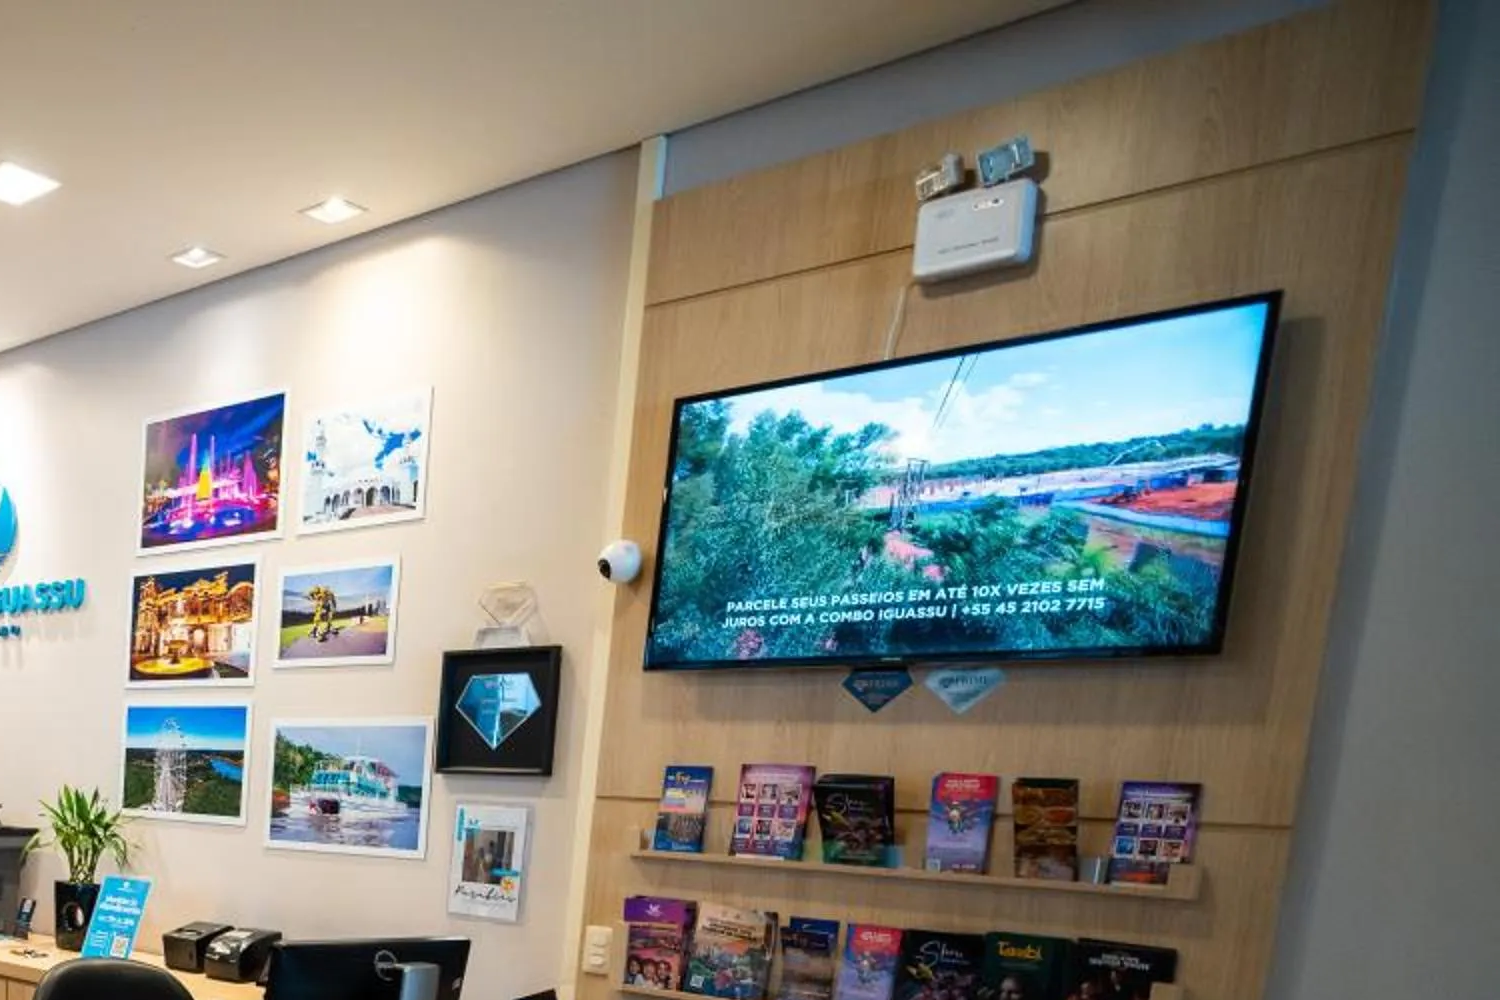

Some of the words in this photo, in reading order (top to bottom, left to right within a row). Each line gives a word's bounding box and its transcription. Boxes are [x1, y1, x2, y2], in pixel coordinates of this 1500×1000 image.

[727, 598, 787, 612] PARCELE
[791, 596, 827, 609] SEUS
[831, 591, 904, 606] PASSEIOS
[908, 588, 931, 602] EM
[935, 583, 968, 600] ATÉ
[972, 585, 1001, 598] 10X
[1007, 581, 1062, 596] VEZES
[1067, 578, 1105, 593] SEM
[722, 615, 766, 629] JUROS
[769, 613, 801, 626] COM
[804, 613, 815, 625] A
[819, 609, 875, 623] COMBO
[878, 605, 948, 621] IGUASSU
[961, 603, 991, 617] +55
[995, 601, 1017, 614] 45
[1020, 599, 1061, 613] 2102
[1065, 597, 1106, 612] 7715
